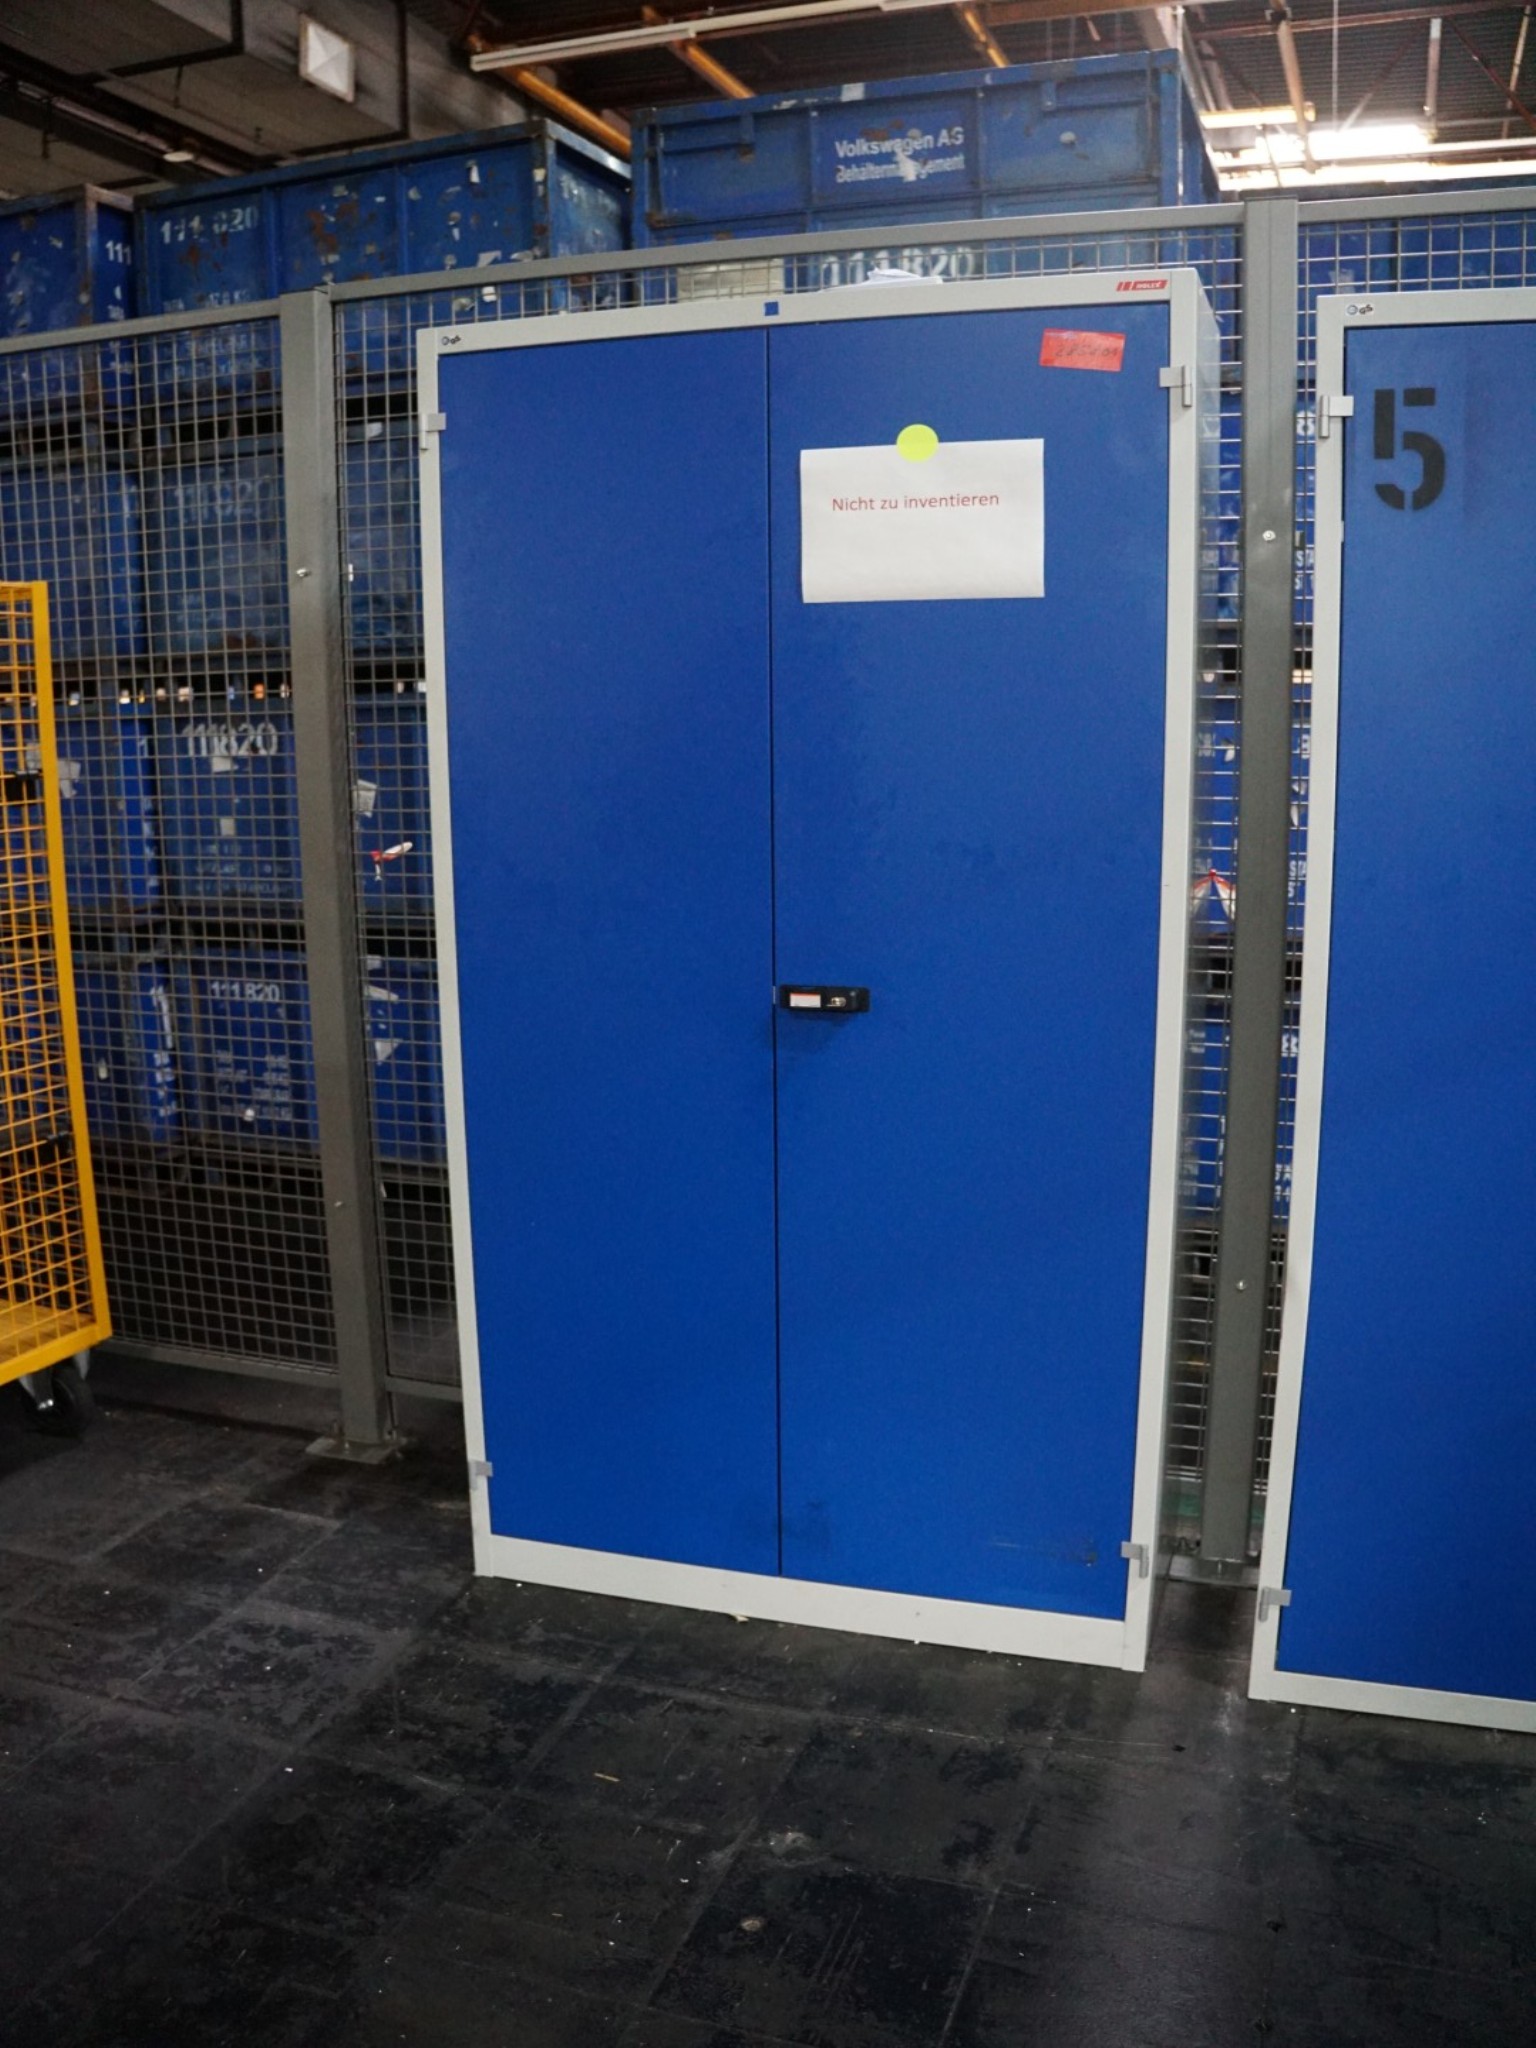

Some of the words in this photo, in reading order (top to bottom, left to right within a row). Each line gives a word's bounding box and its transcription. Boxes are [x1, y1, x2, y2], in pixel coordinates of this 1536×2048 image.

[834, 134, 934, 158] Volkswagen
[937, 126, 964, 147] AG
[1373, 386, 1446, 512] 5
[832, 497, 875, 511] Nicht
[880, 498, 898, 510] zu
[903, 493, 999, 509] inventieren
